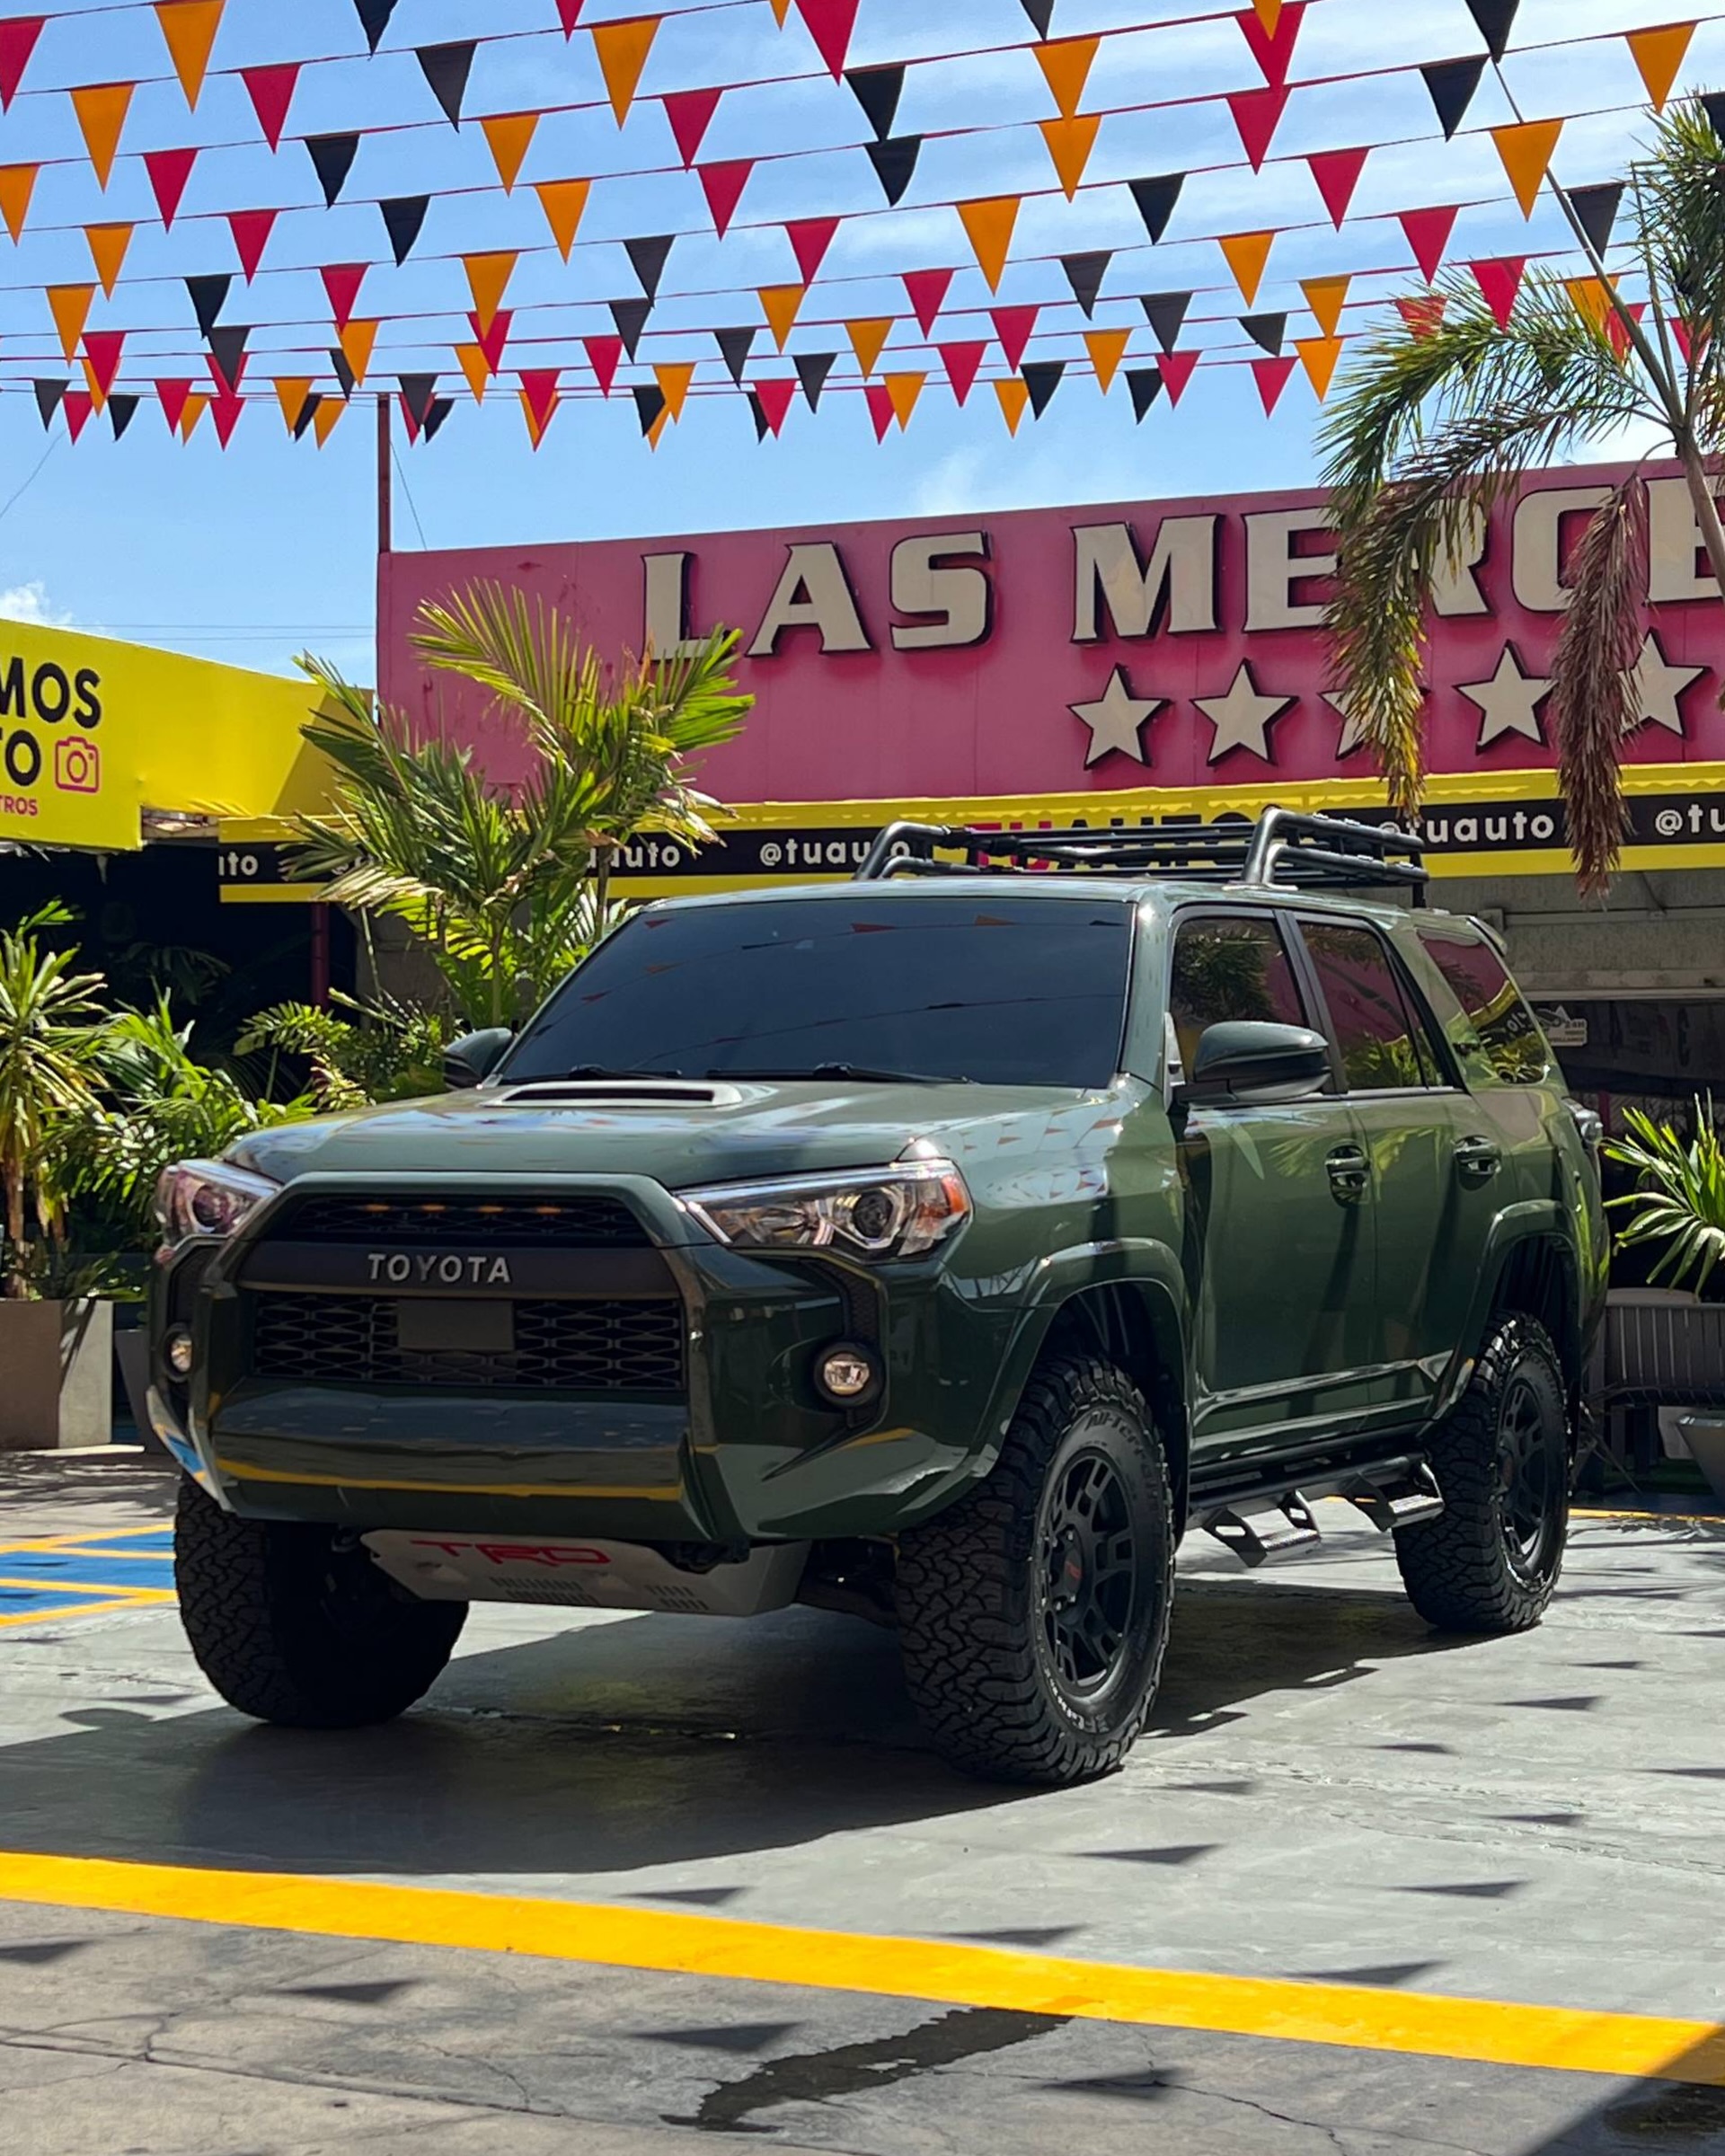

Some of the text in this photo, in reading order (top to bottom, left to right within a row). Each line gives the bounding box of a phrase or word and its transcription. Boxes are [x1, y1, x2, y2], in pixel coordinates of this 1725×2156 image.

[641, 530, 995, 663] LAS
[0, 728, 41, 787] O
[0, 794, 39, 816] ROS
[759, 838, 911, 867] @tuauo
[367, 1253, 511, 1284] TOYOTA
[410, 1540, 612, 1568] TRD
